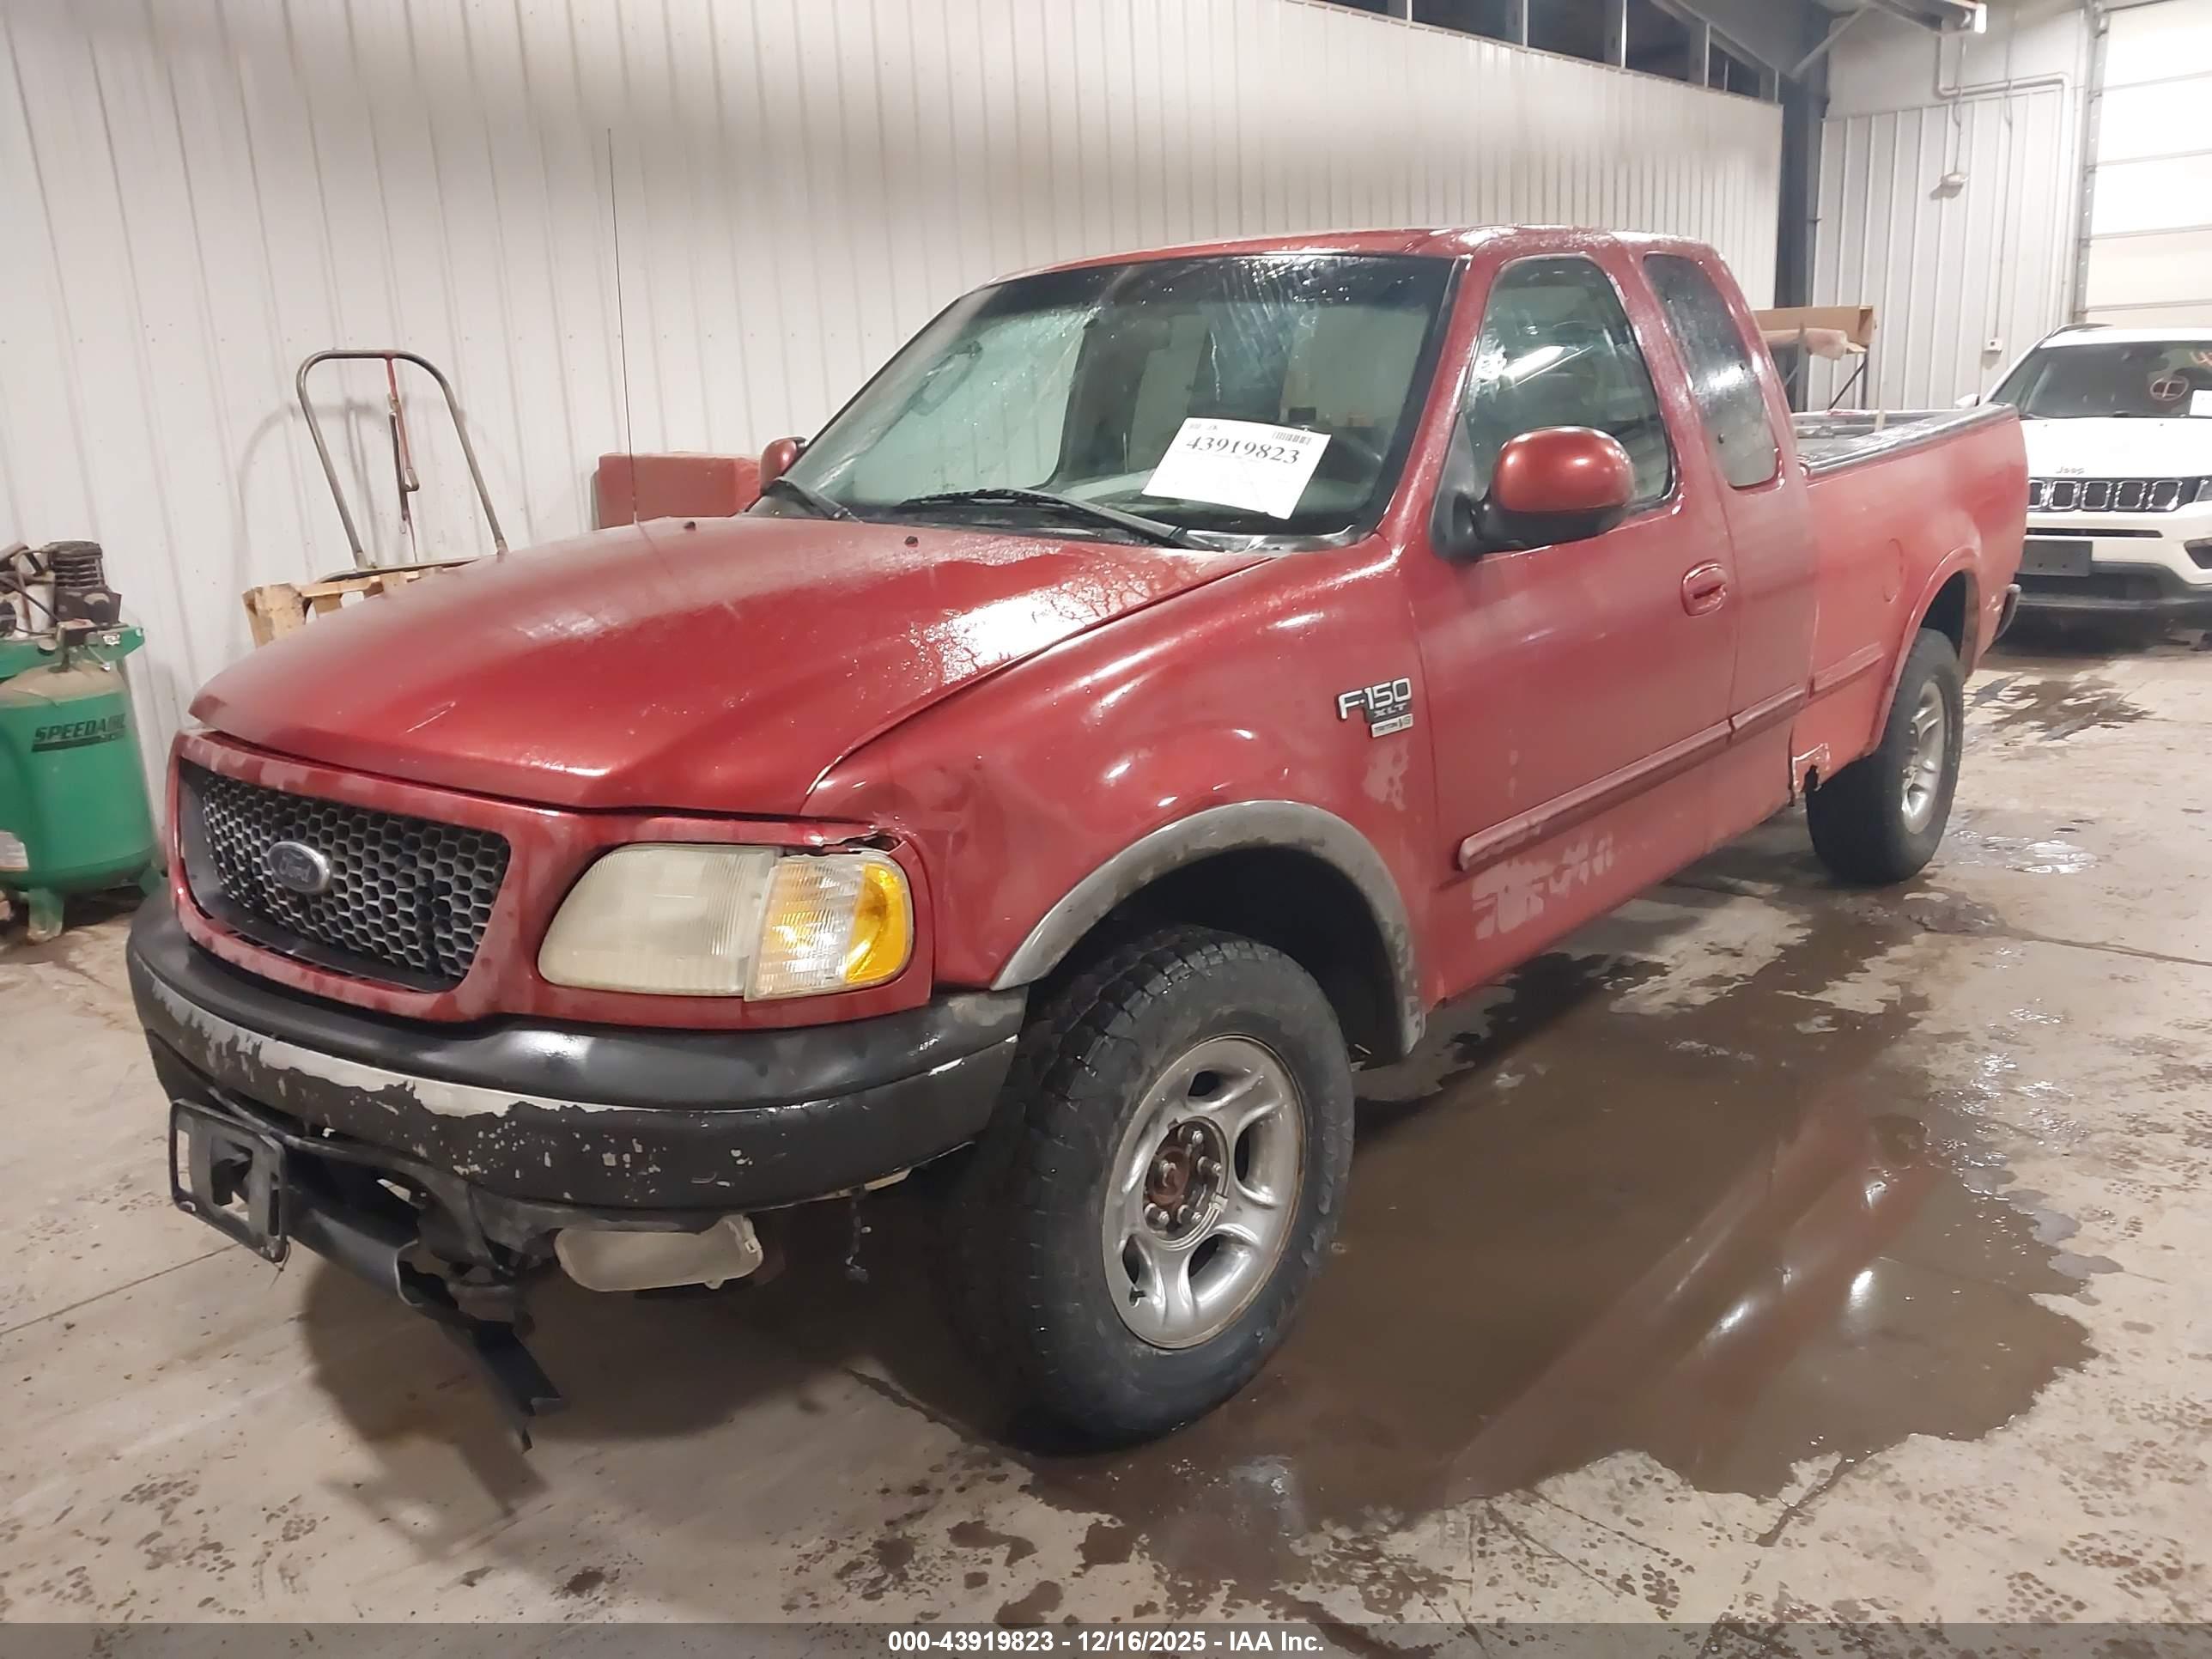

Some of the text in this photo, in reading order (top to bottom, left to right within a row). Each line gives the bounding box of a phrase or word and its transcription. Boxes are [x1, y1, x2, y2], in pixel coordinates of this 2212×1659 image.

[1186, 436, 1299, 464] 43919823
[2055, 465, 2085, 476] Jeep
[1374, 702, 1407, 717] XLT
